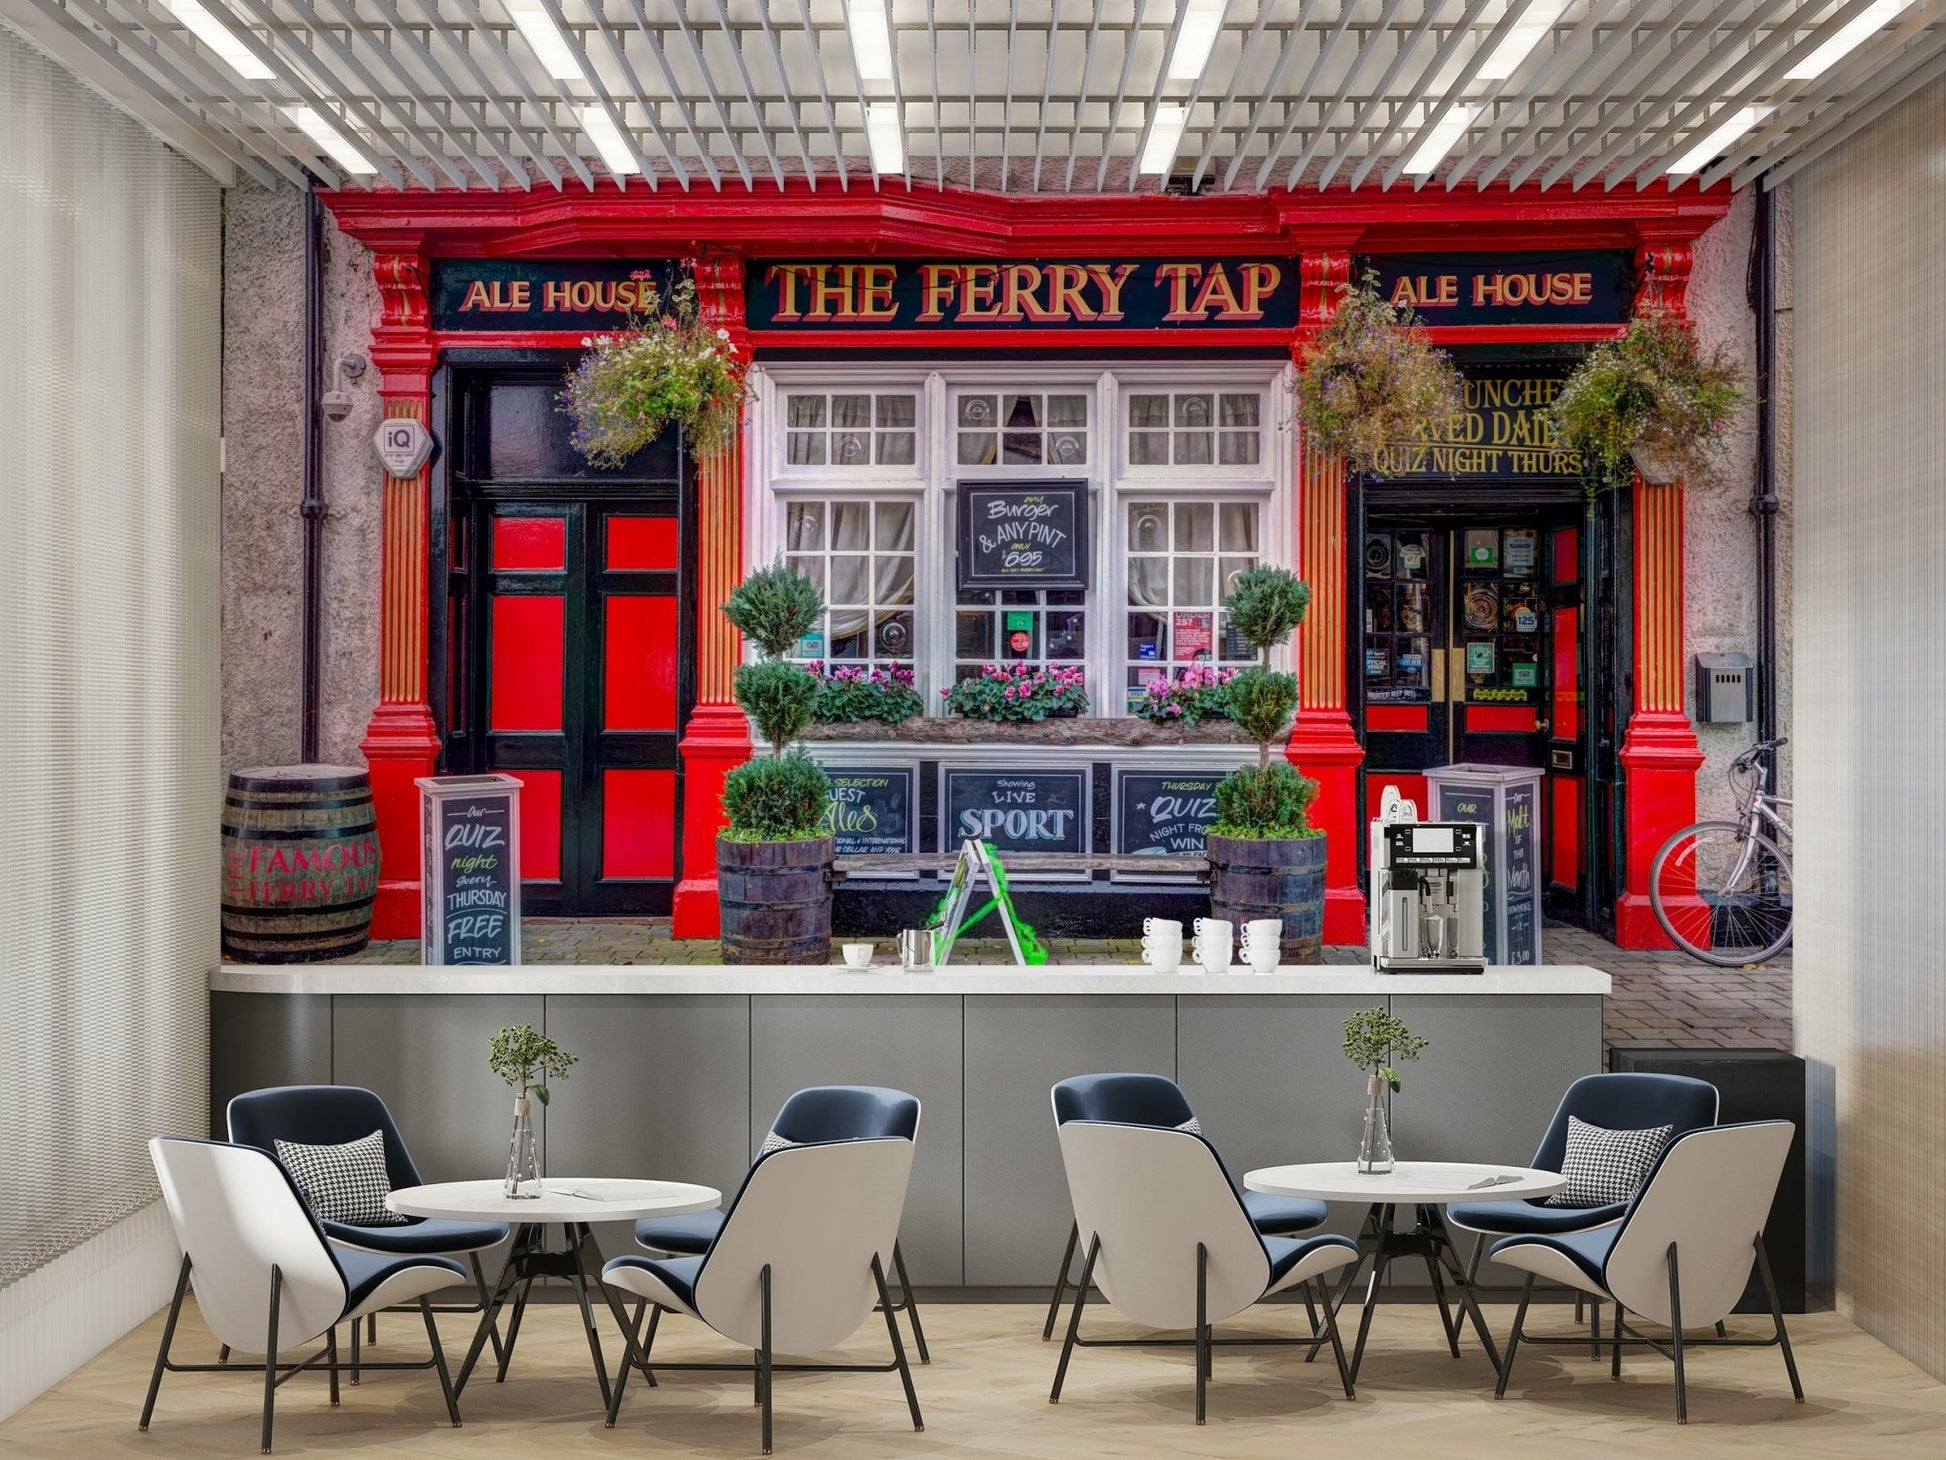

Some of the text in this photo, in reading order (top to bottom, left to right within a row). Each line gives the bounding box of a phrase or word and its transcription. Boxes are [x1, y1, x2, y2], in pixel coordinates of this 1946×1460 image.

[458, 281, 657, 312] ALE HOUSE
[765, 262, 1282, 322] THE FERRY TAP
[1390, 272, 1593, 307] ALE HOUSE
[388, 429, 410, 448] iQ
[1374, 446, 1583, 474] QUIZ NIGHT THURS
[987, 500, 1059, 521] Burger
[979, 521, 1067, 553] & ANY PINT
[1518, 616, 1535, 625] 125
[834, 778, 889, 787] SELECTION
[1162, 781, 1212, 791] THURSDAY
[992, 791, 1035, 803] LIVE
[467, 805, 486, 818] Our
[817, 801, 878, 833] Ales
[1150, 796, 1218, 824] QUIZ
[958, 808, 1075, 840] SPORT
[1149, 823, 1186, 842] NIGHT
[445, 823, 506, 850] QUIZ
[1170, 837, 1204, 850] WIN
[249, 838, 378, 874] FAMOUS
[451, 854, 499, 874] night
[248, 877, 334, 903] FERRY
[447, 889, 507, 911] THURSDAY
[447, 914, 504, 944] FREE
[454, 947, 502, 959] ENTRY
